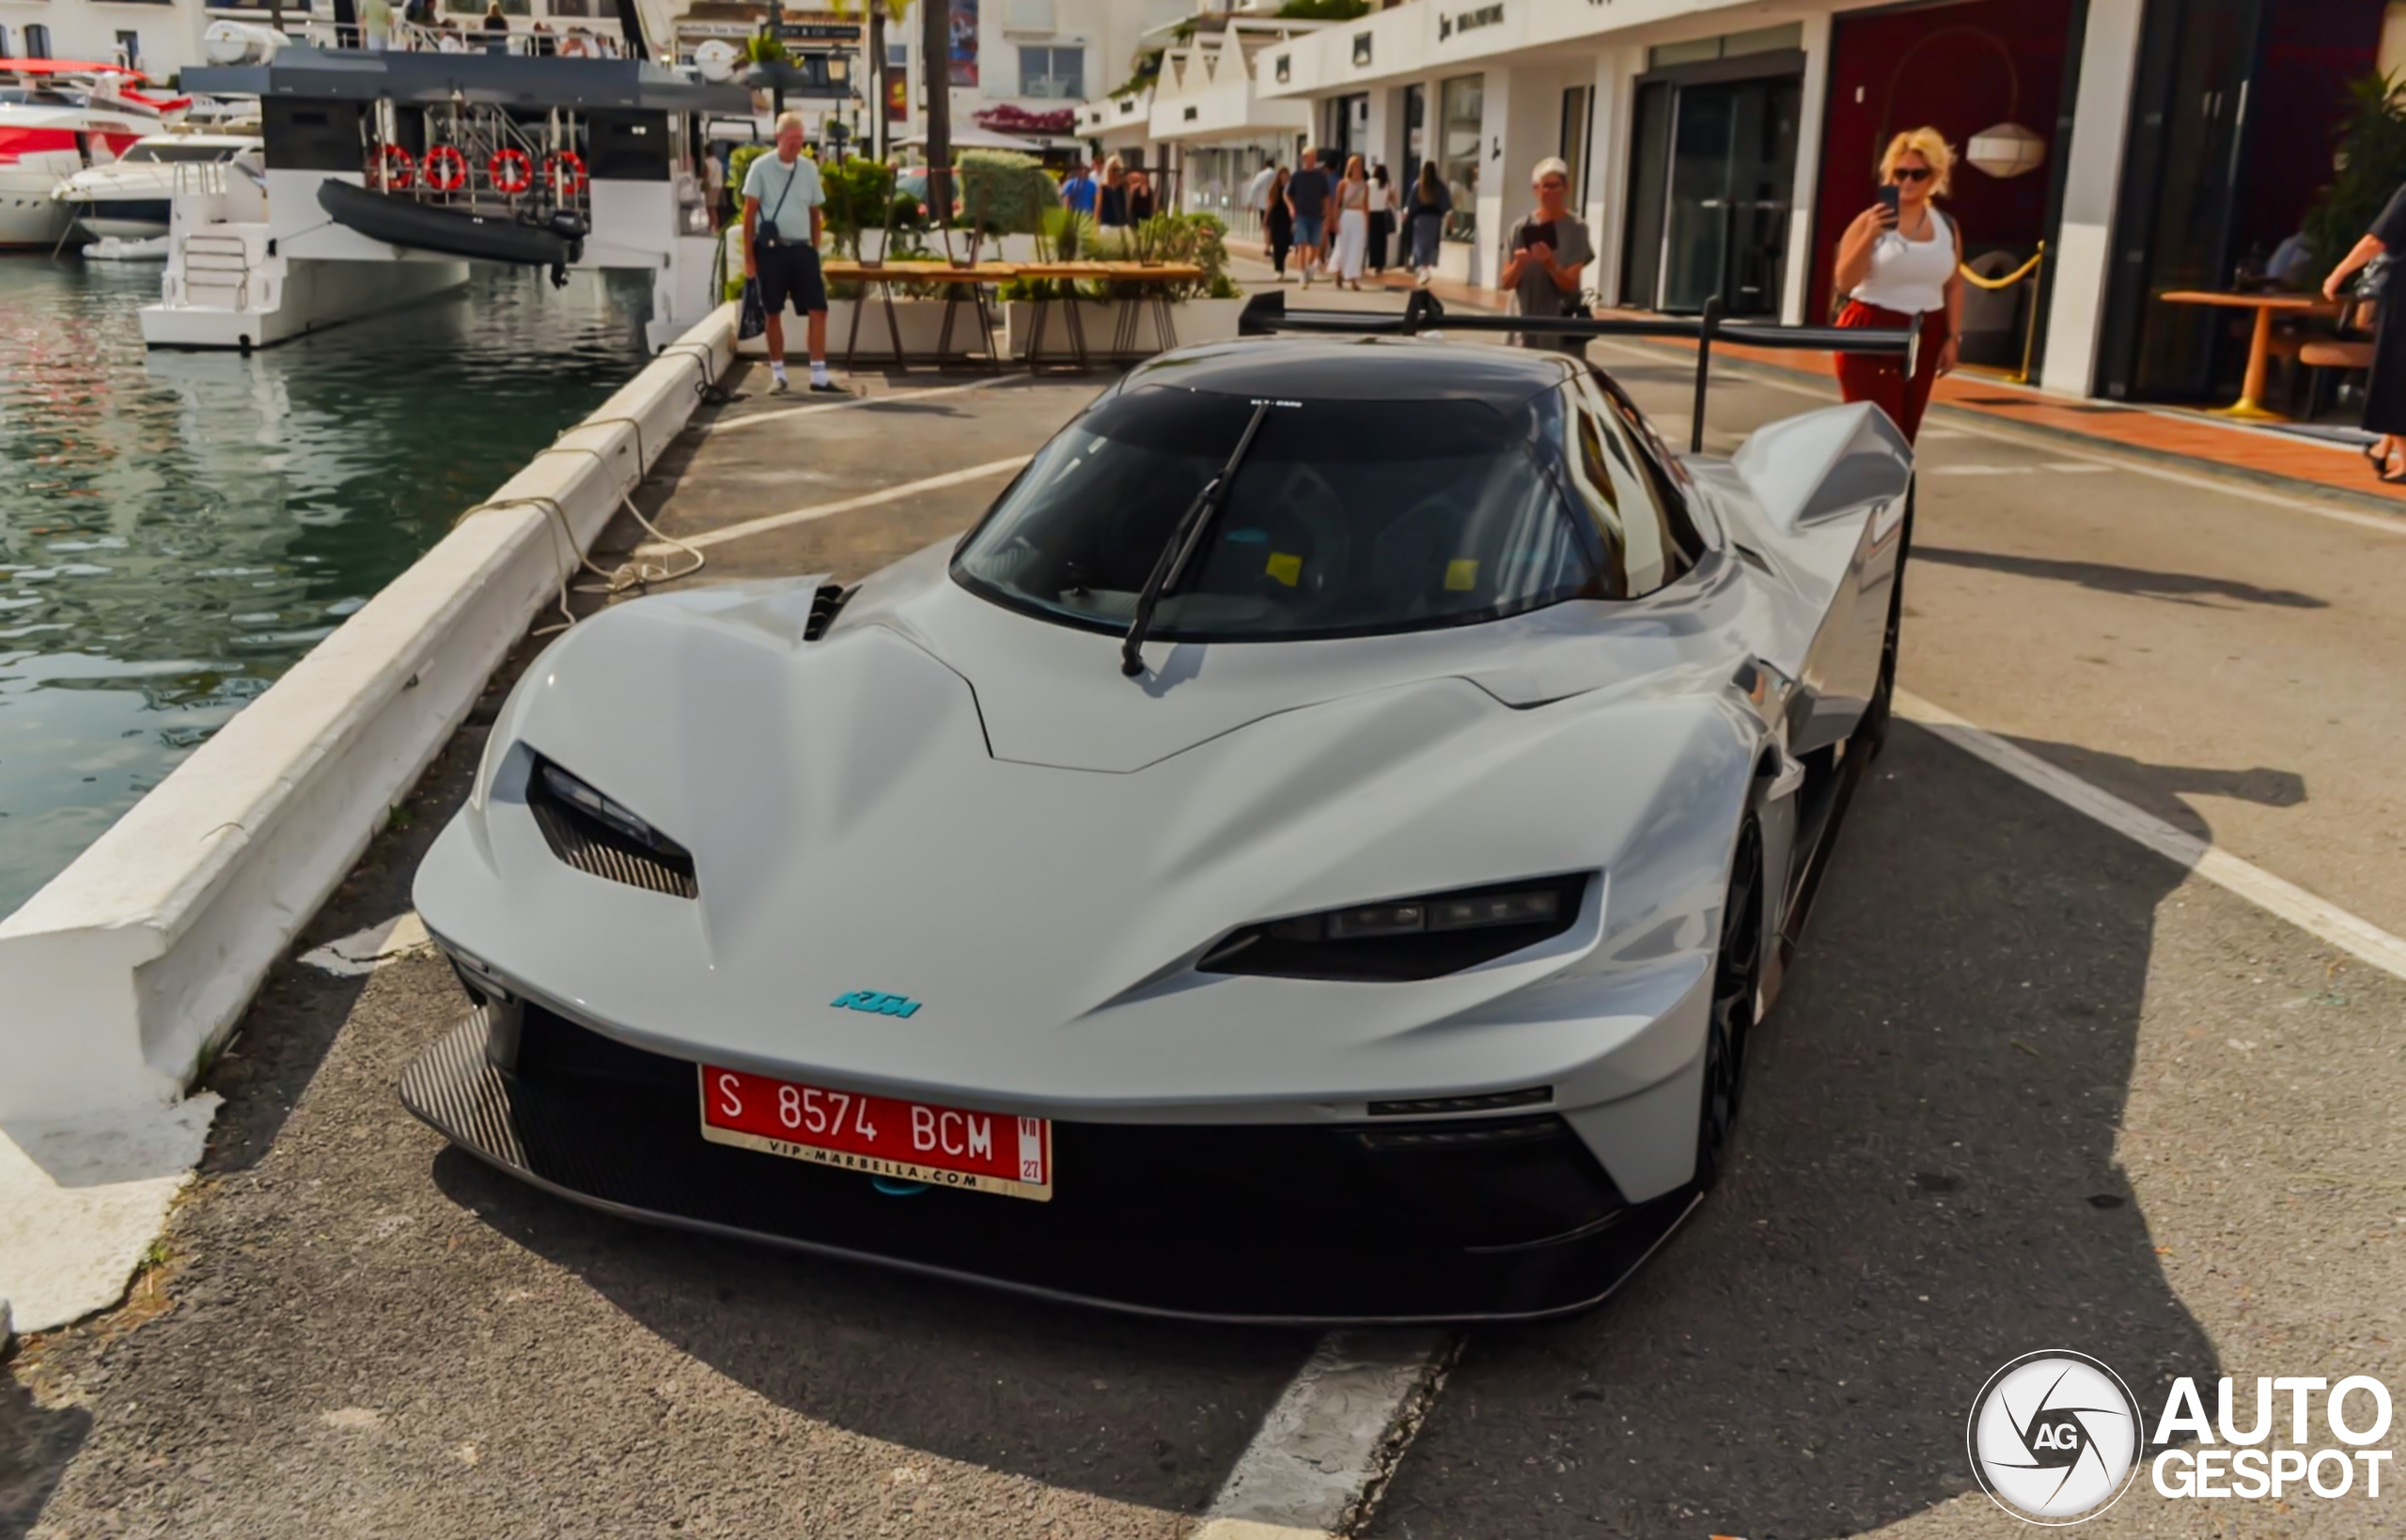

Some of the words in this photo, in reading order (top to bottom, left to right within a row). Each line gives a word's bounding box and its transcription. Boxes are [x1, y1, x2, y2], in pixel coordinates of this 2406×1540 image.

[829, 989, 922, 1019] KTM
[719, 1073, 742, 1117] S
[778, 1085, 877, 1142] 8574
[911, 1106, 992, 1160] BCM
[770, 1141, 976, 1187] VIP-MARBELLA.COM
[1023, 1159, 1039, 1178] 27
